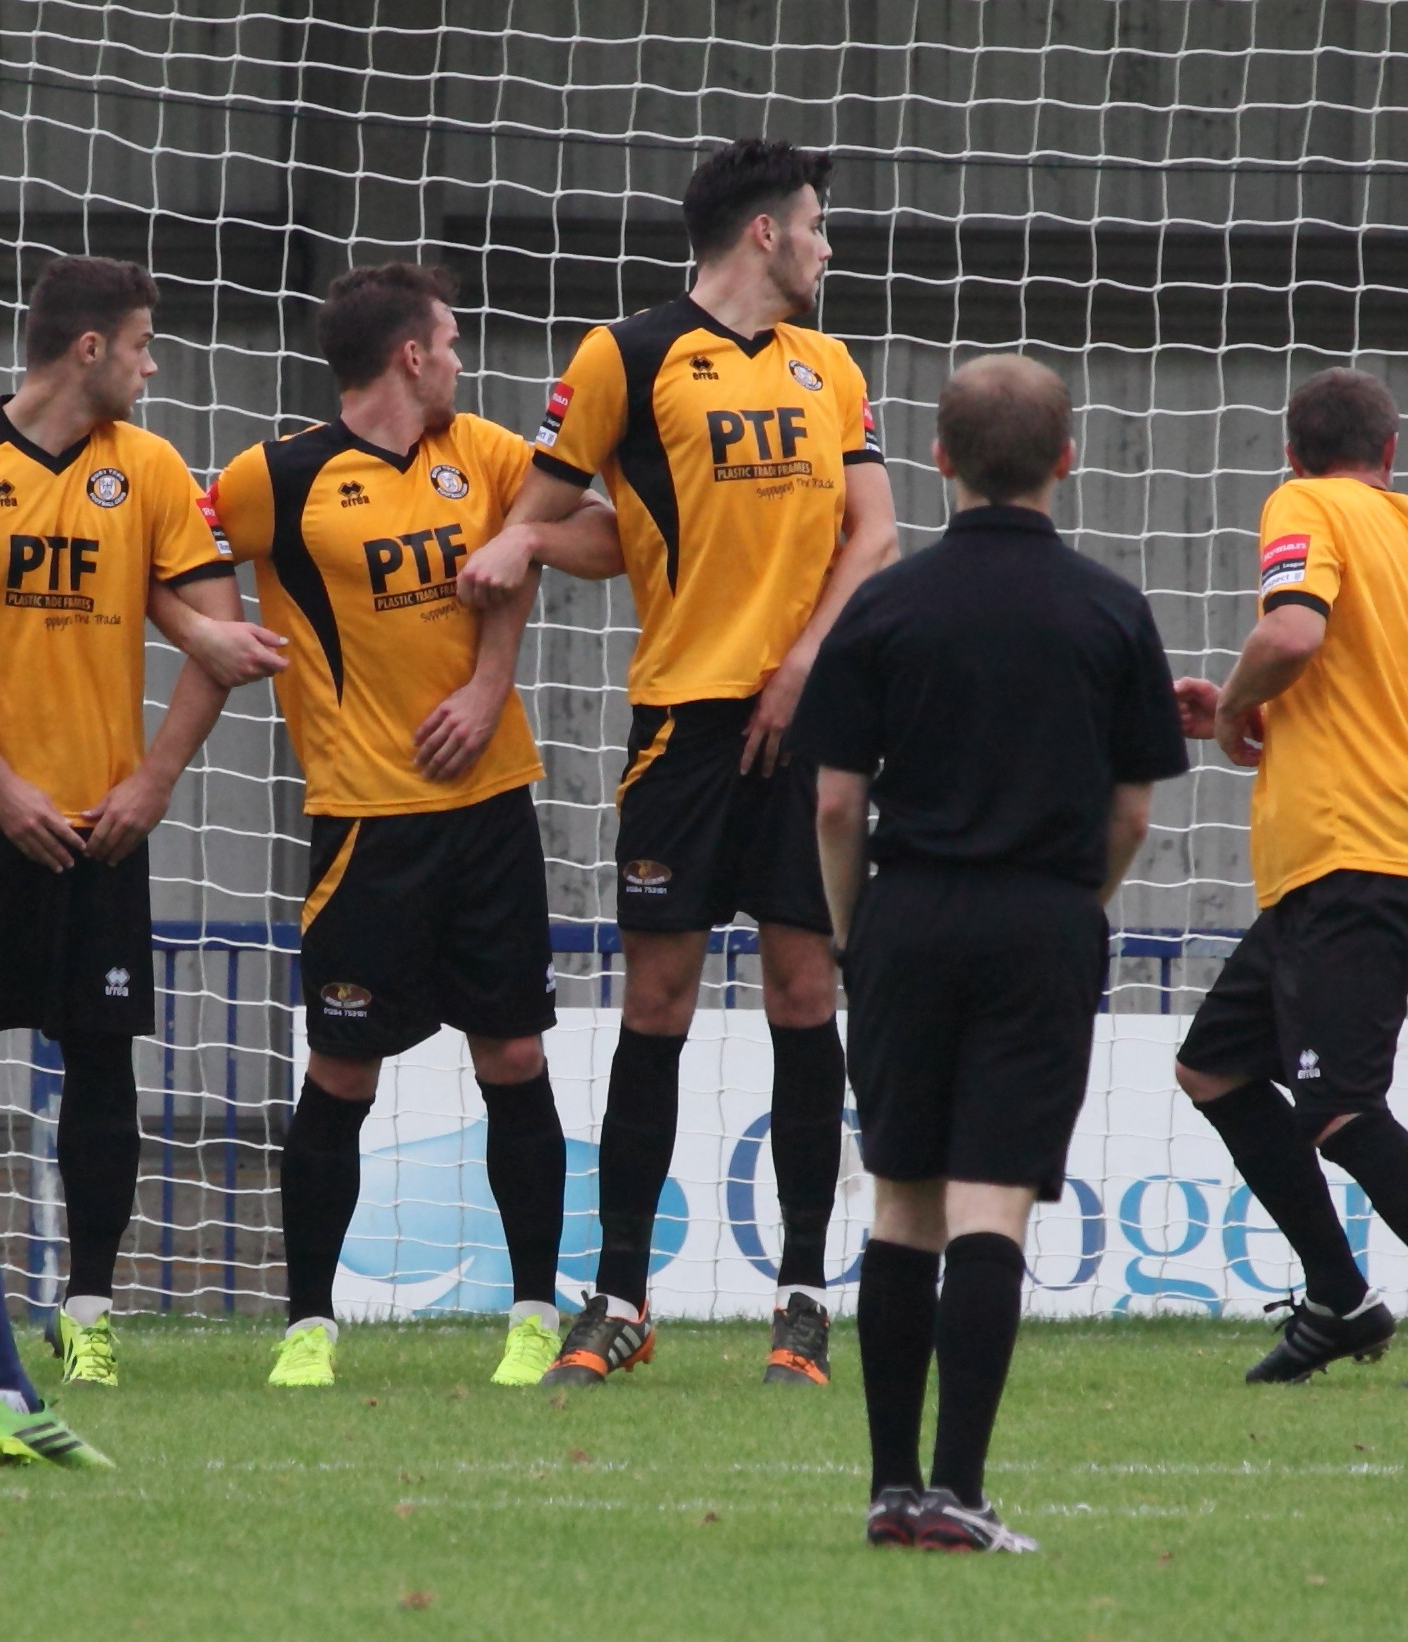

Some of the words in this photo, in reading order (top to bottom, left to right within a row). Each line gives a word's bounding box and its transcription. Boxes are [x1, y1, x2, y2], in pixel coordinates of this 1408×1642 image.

[707, 408, 809, 464] PTF
[717, 467, 751, 479] PLASTIC
[7, 535, 99, 591] PTF
[363, 523, 467, 594] PTF
[9, 593, 42, 606] PLASTIC
[377, 593, 413, 609] PLASTIC
